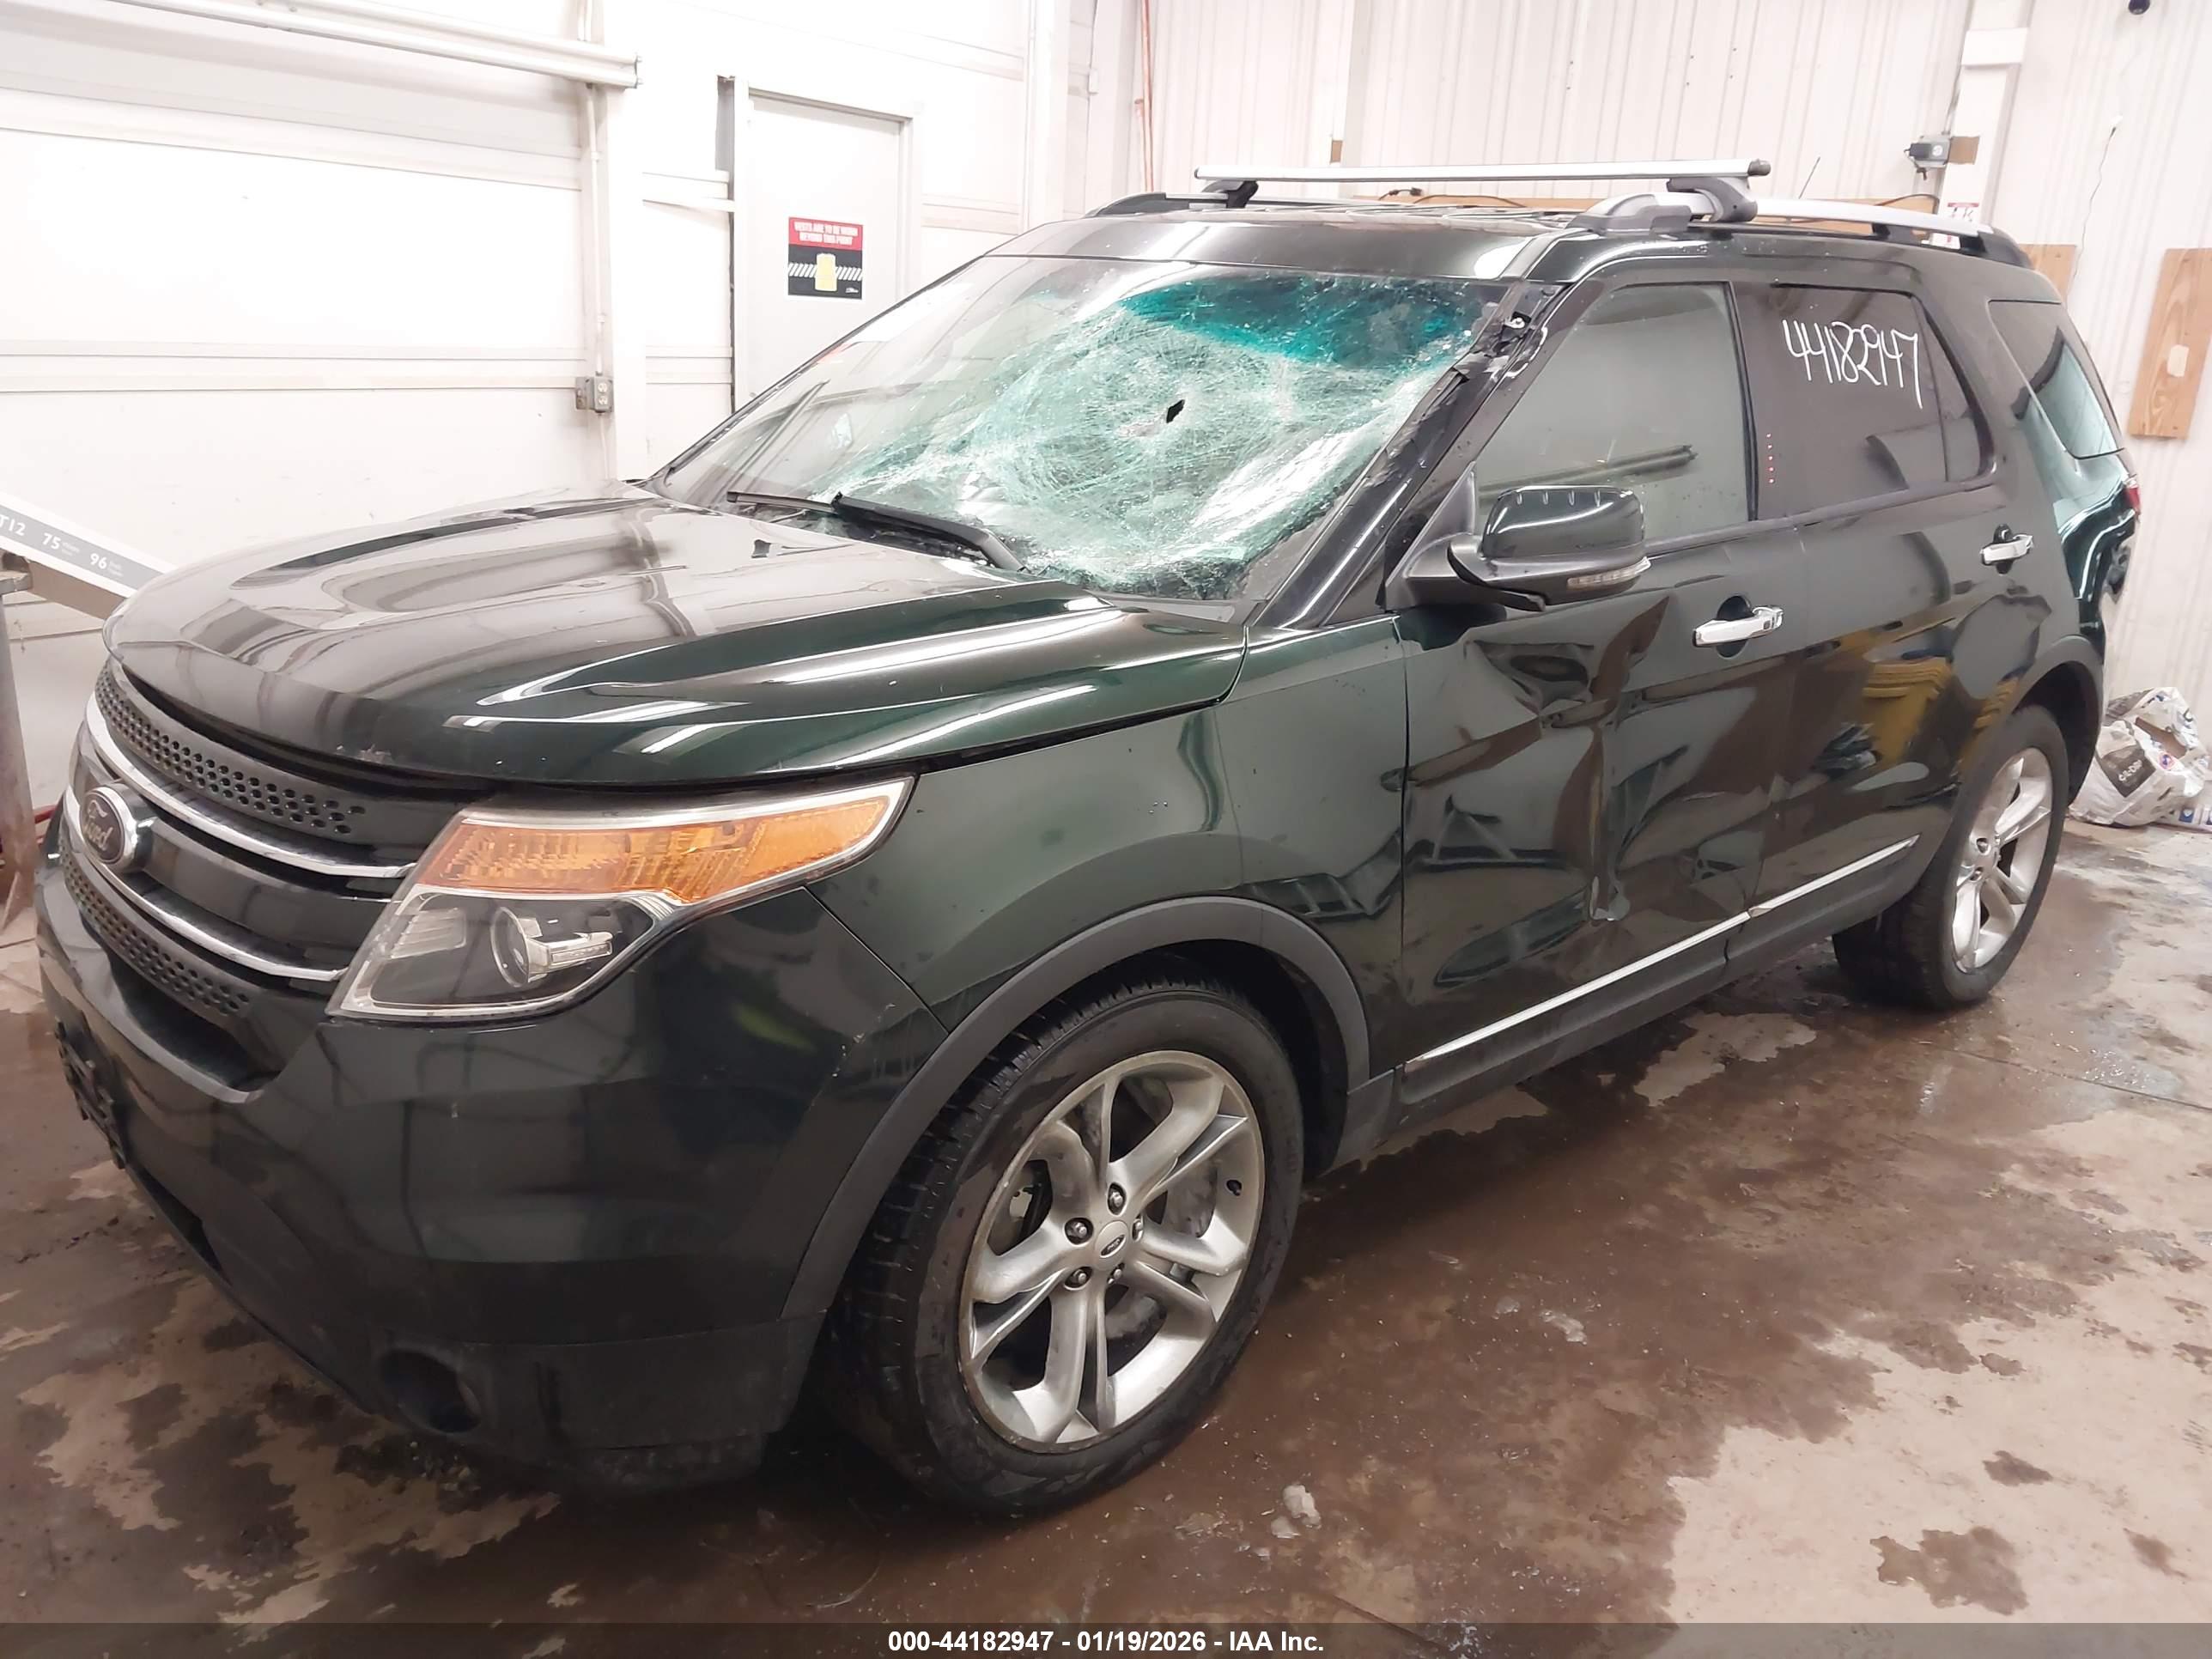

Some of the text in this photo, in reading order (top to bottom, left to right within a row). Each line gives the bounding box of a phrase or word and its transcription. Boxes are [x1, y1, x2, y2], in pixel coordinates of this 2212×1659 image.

[1782, 319, 1923, 410] 44182947
[42, 532, 61, 550] 75
[90, 552, 107, 569] 96
